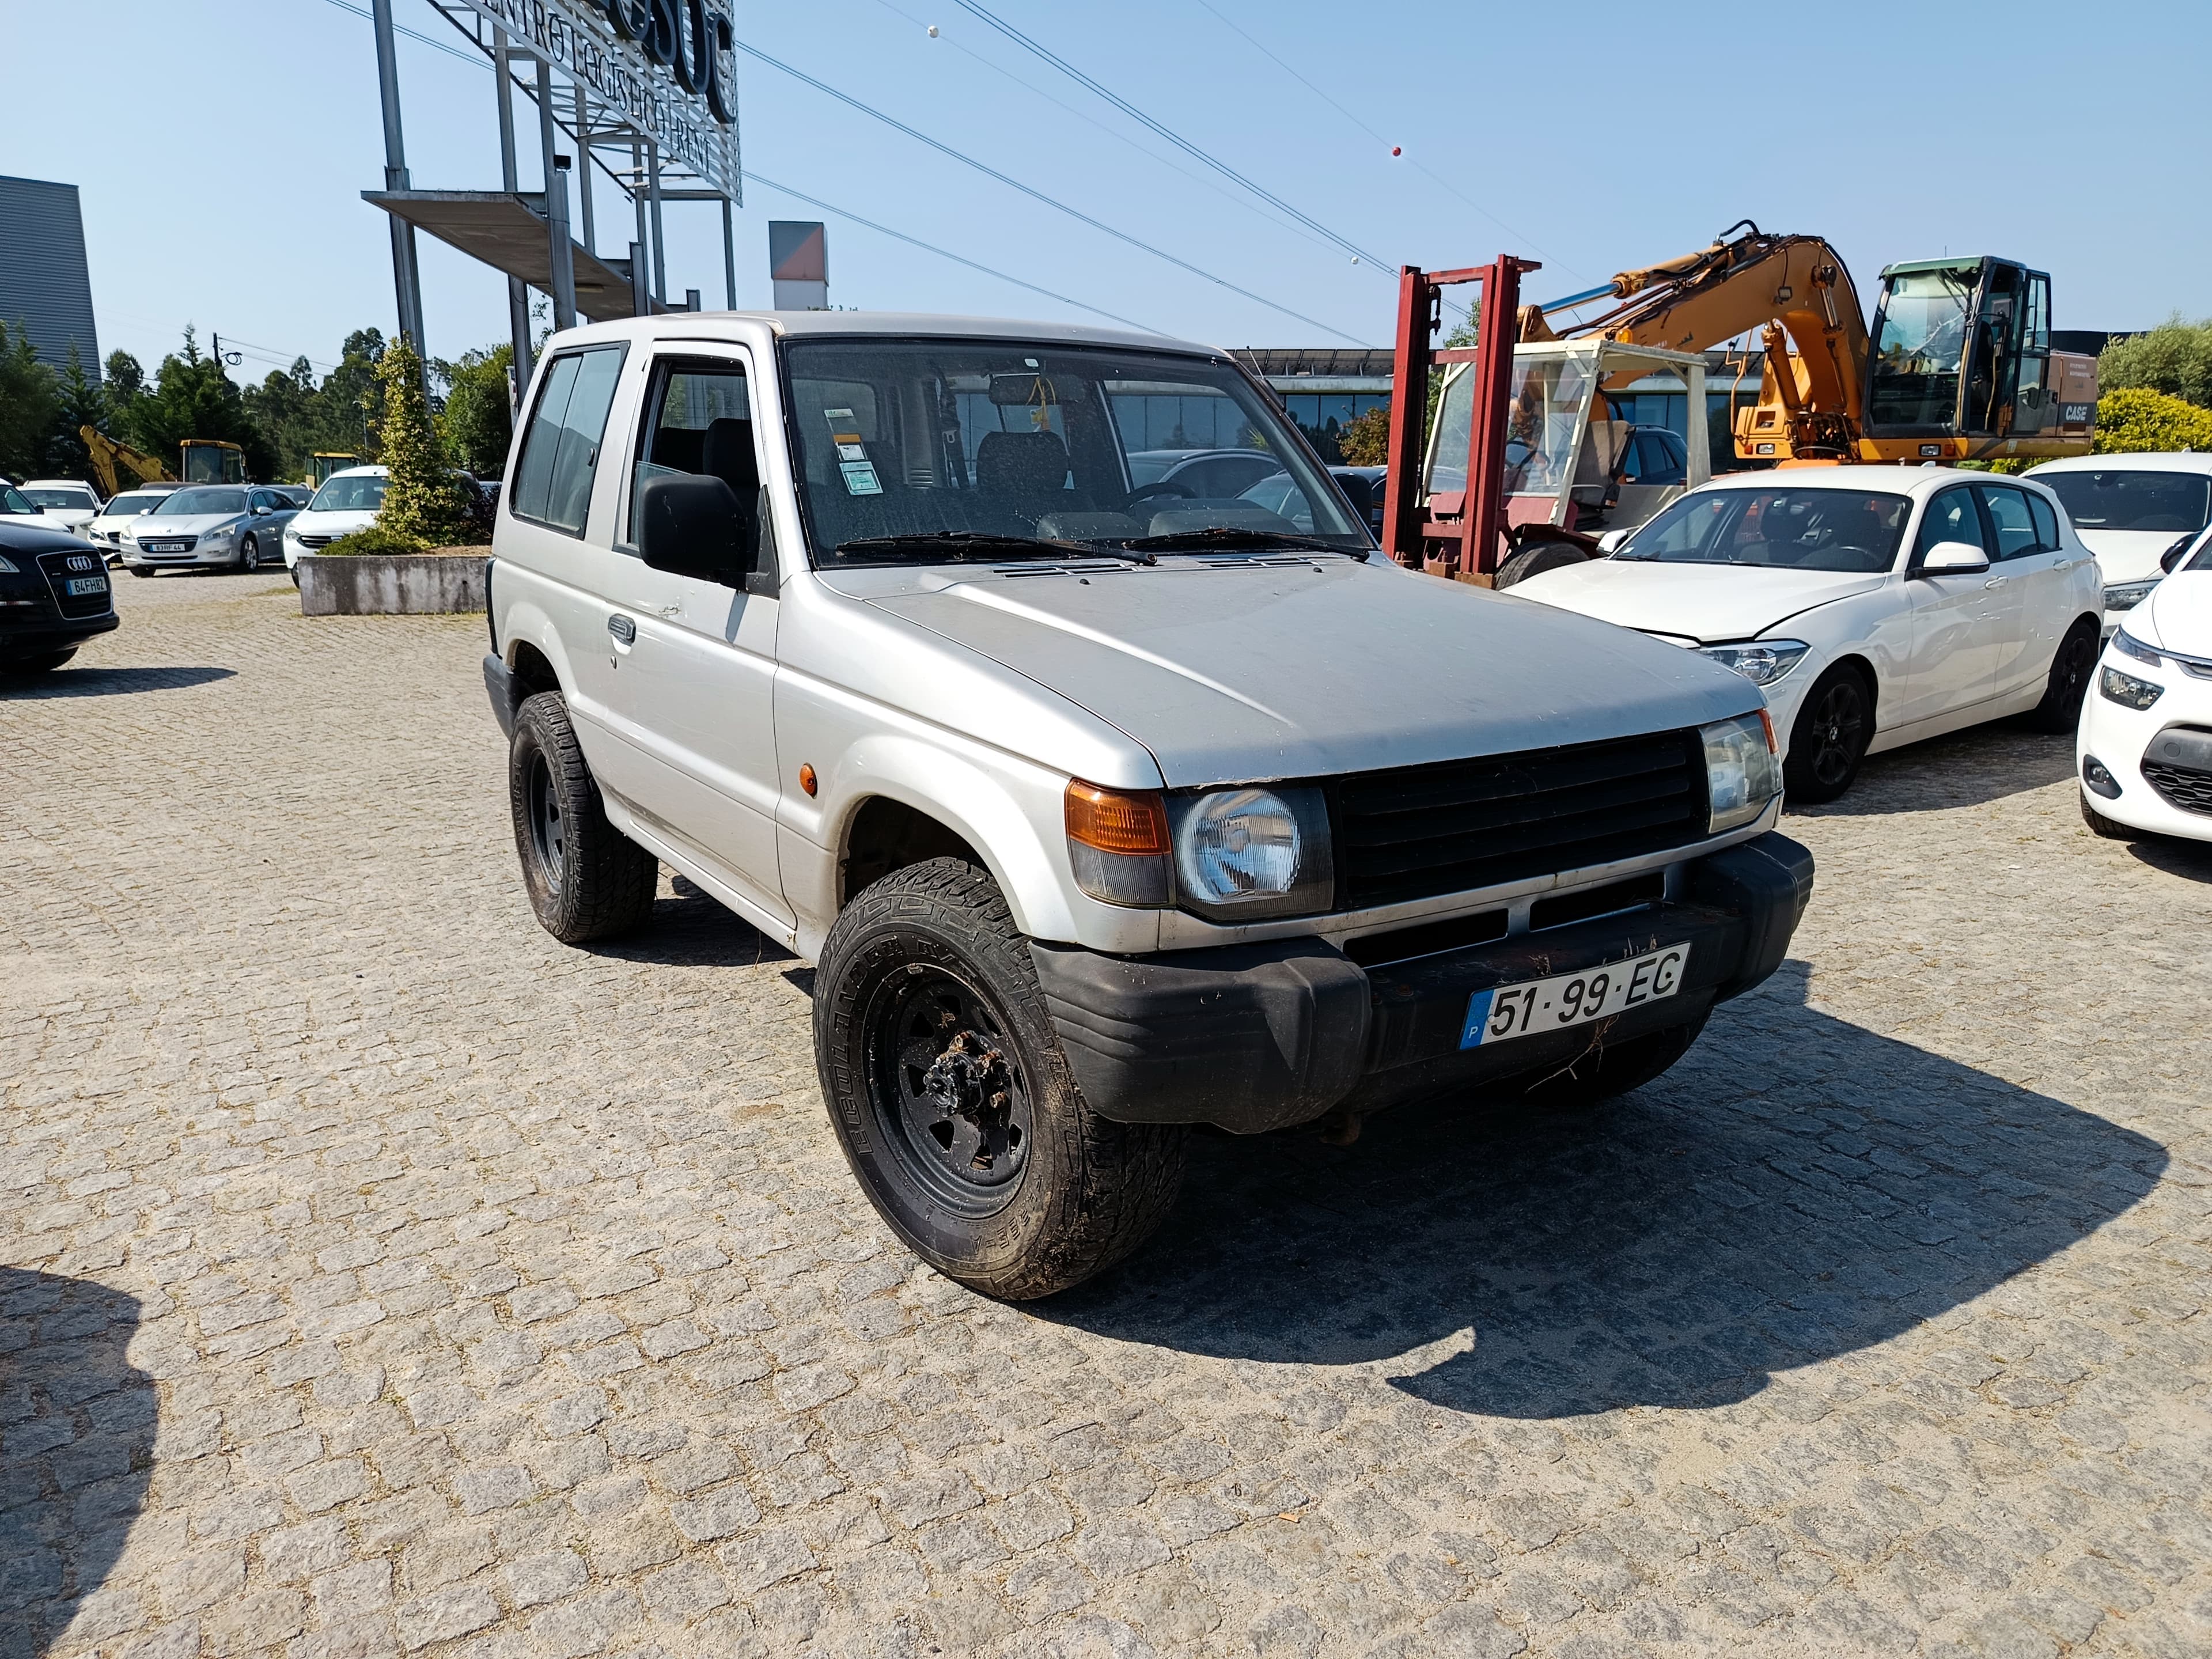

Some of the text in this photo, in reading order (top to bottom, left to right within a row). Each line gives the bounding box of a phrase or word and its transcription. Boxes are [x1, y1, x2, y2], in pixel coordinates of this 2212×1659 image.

[2066, 405, 2088, 421] CASE
[1468, 1025, 1479, 1039] P
[831, 936, 903, 1155] ECOLANDER
